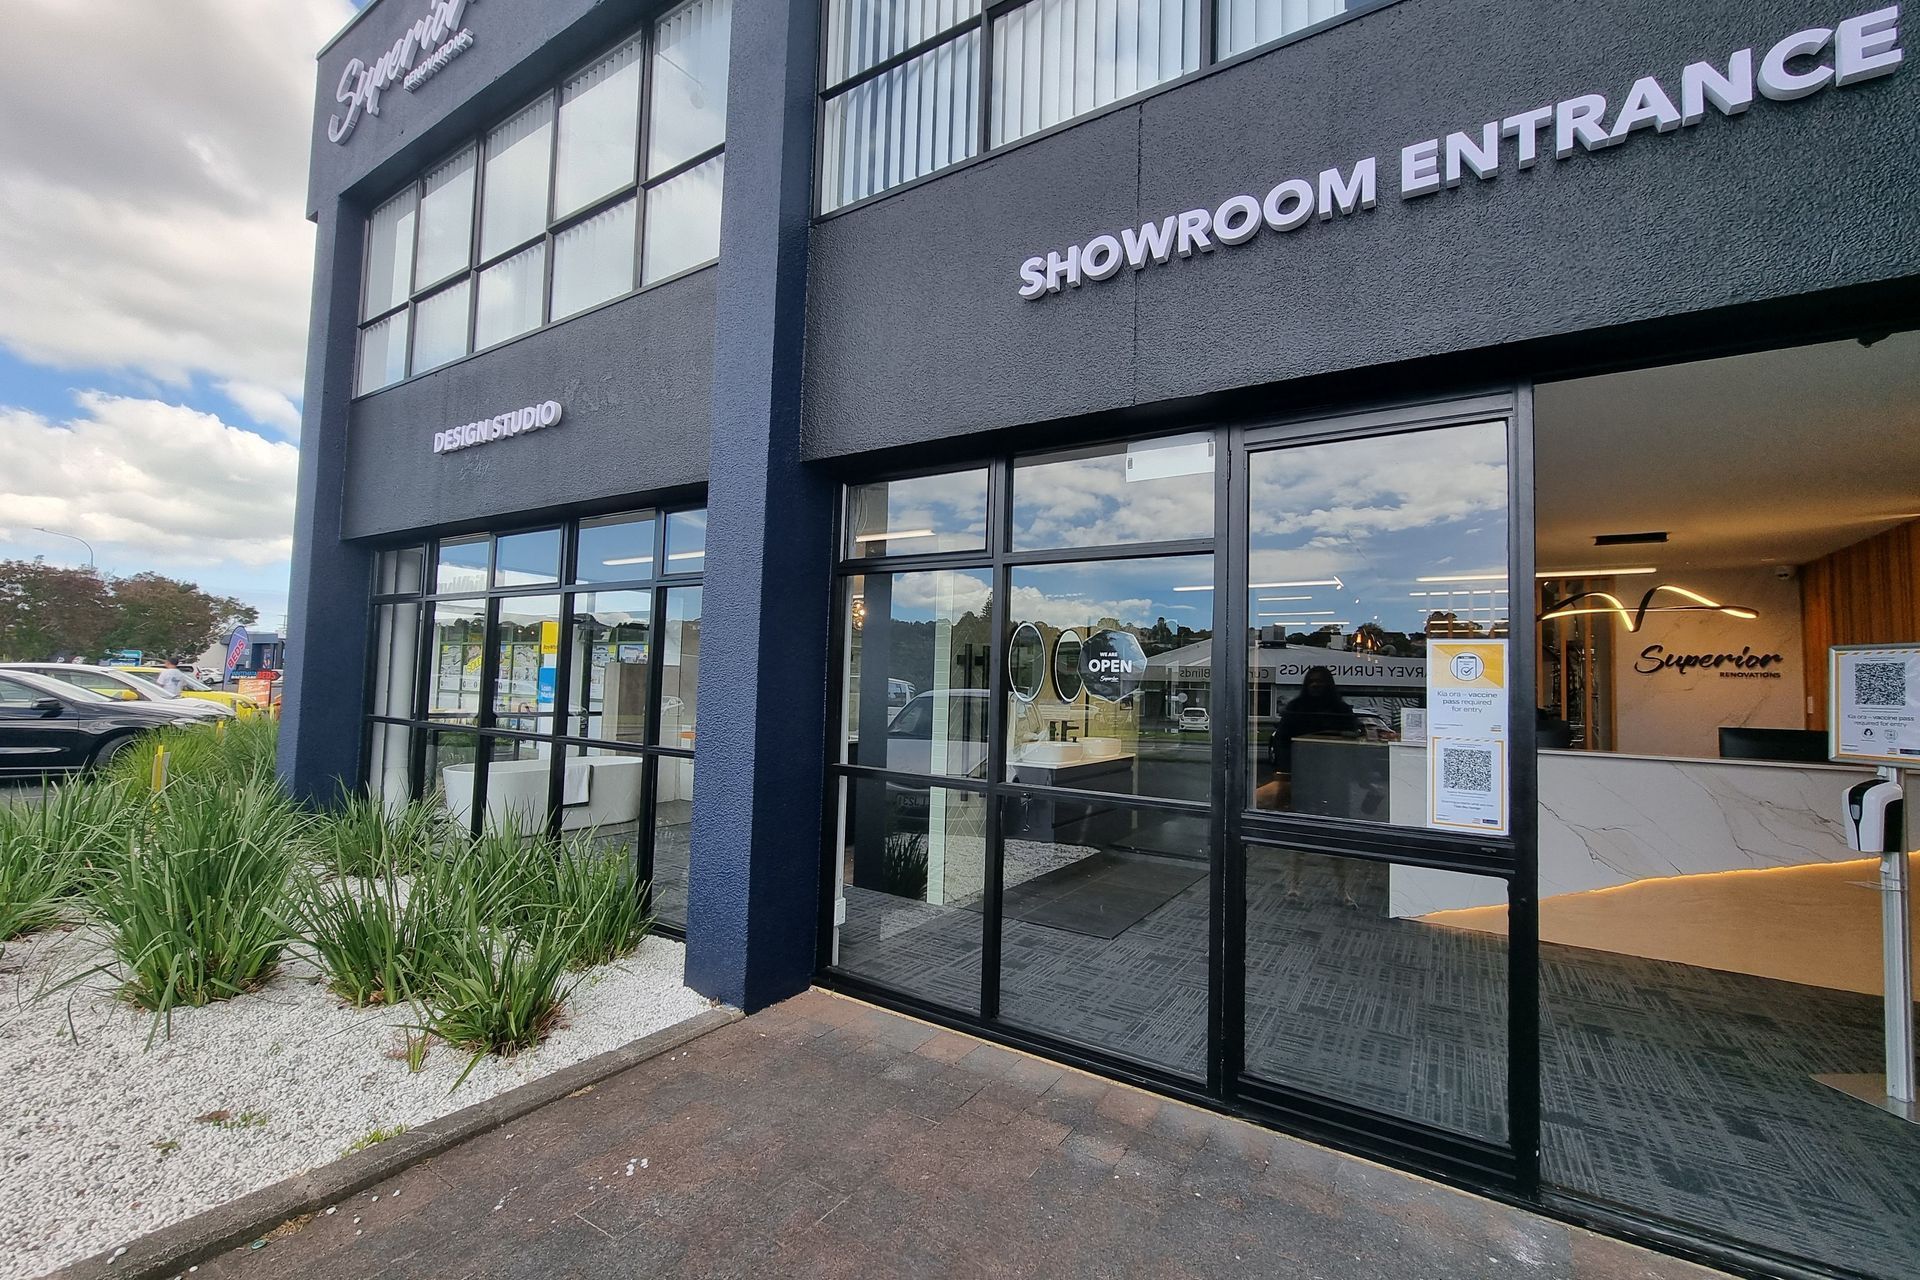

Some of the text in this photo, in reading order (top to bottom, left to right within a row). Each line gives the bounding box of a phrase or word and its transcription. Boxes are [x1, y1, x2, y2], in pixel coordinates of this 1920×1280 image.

[403, 28, 475, 94] RENOVATIONS
[1018, 5, 1902, 300] SHOWROOM ENTRANCE
[433, 400, 562, 455] DESIGN STUDIO
[227, 640, 246, 668] BEDS
[1088, 659, 1133, 673] OPEN
[1634, 644, 1783, 675] Superior
